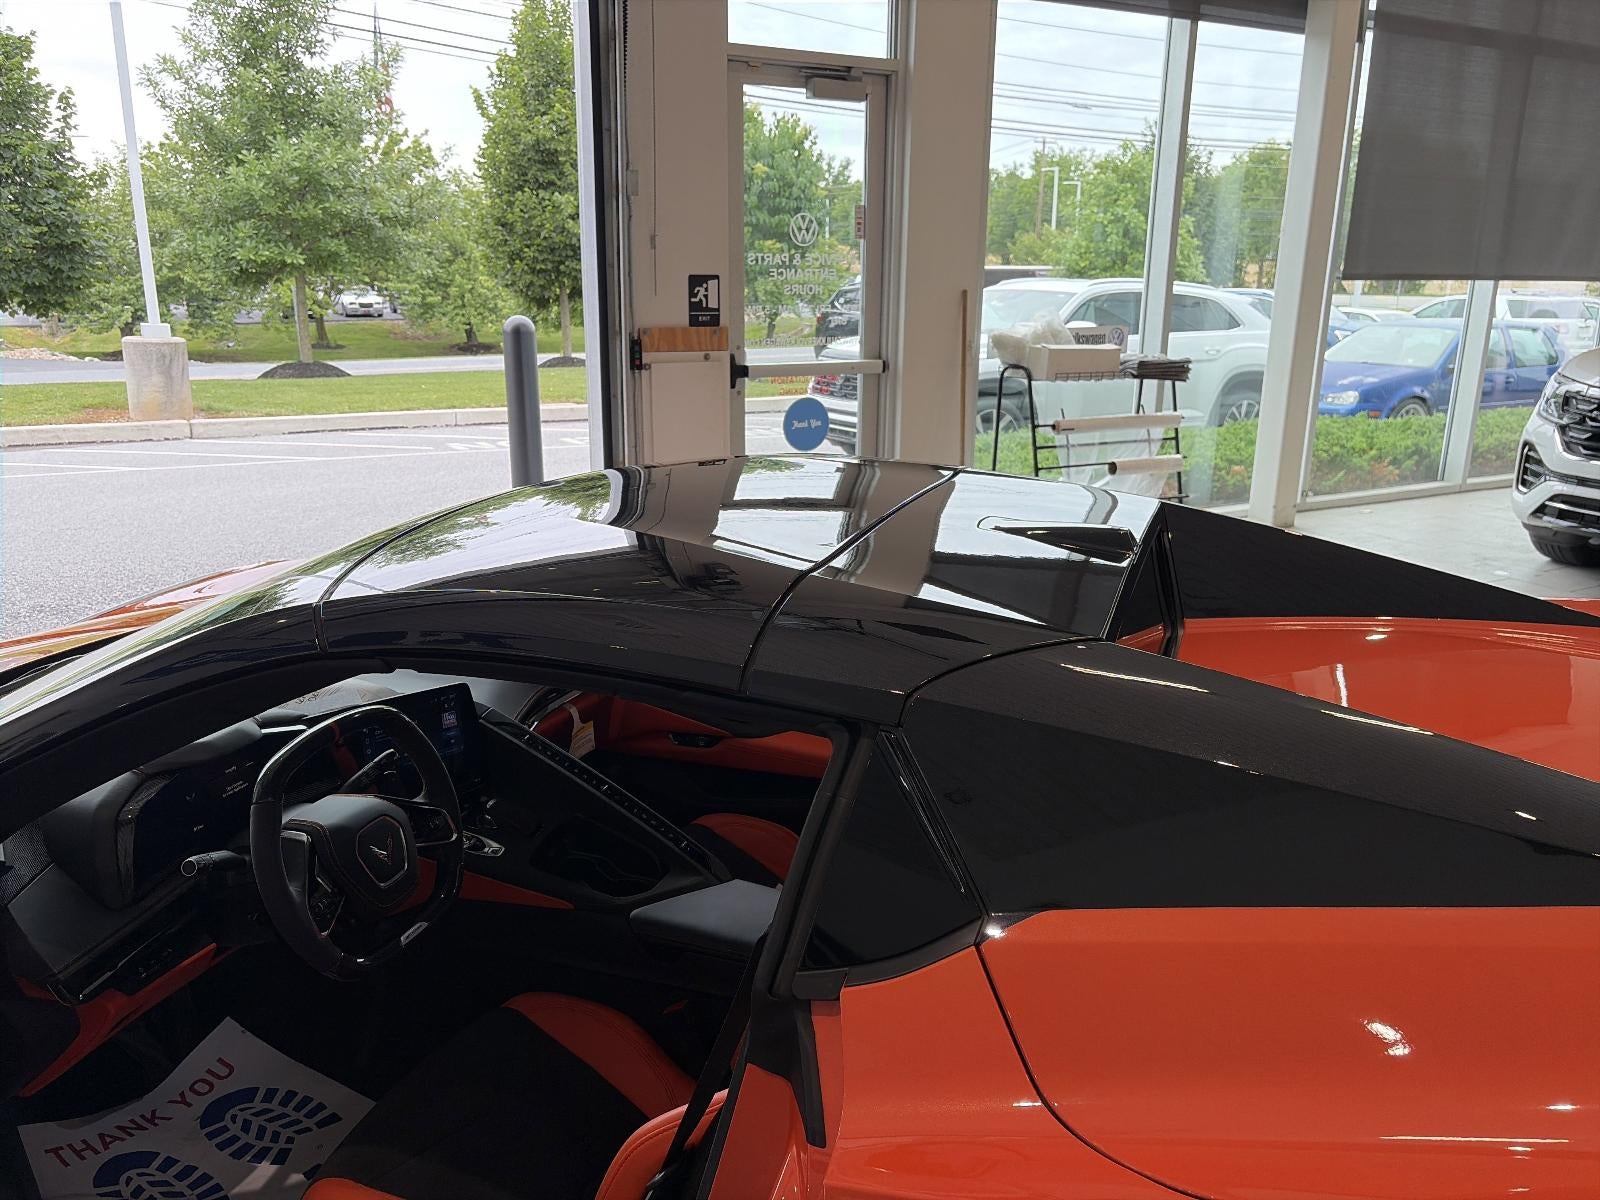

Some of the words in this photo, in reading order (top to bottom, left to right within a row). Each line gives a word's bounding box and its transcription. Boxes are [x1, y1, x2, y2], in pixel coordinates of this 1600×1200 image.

[791, 419, 809, 429] Thank
[809, 418, 822, 429] You
[45, 1108, 173, 1168] THANK
[167, 1057, 235, 1109] YOU
